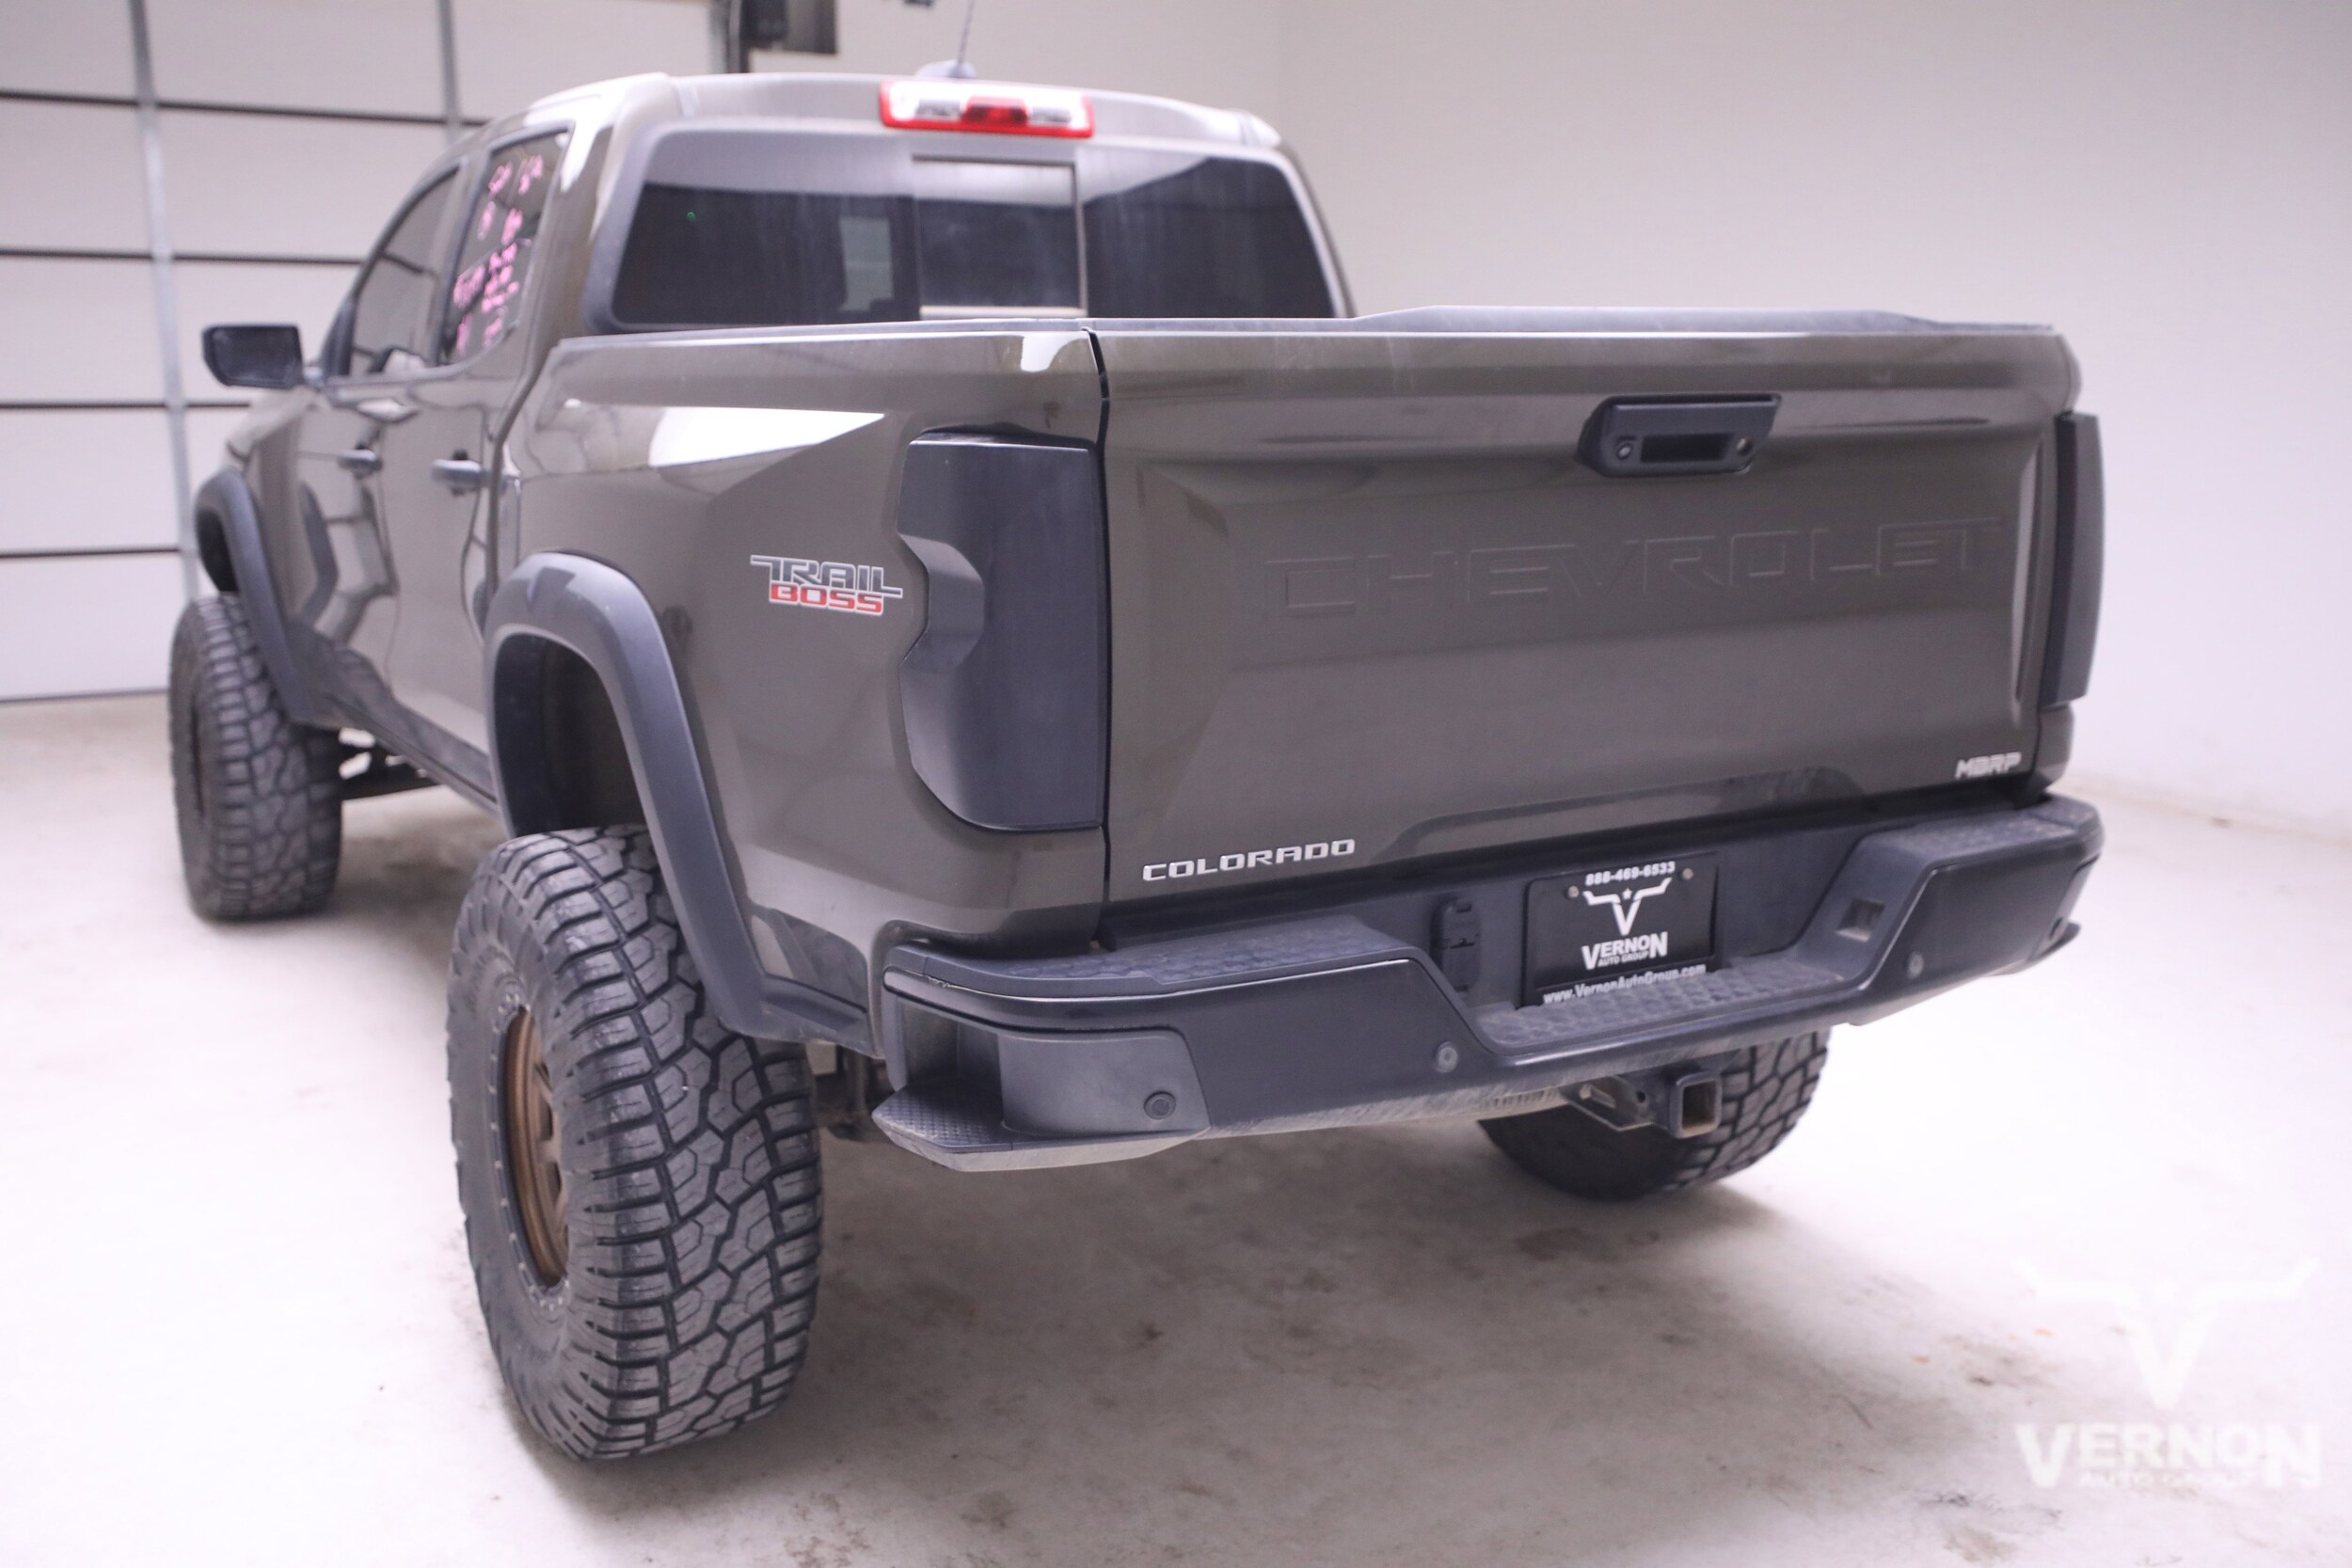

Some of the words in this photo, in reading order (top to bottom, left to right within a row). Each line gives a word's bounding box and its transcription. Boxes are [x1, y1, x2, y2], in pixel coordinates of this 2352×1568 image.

[750, 554, 903, 599] TRAIL
[1263, 516, 2002, 617] CHEVROLET
[769, 581, 883, 616] BOSS
[1142, 838, 1356, 881] COLORADO
[1585, 861, 1676, 886] 888-469-6533
[1581, 931, 1668, 970] VERNON
[1597, 956, 1620, 967] AUTO
[1621, 950, 1649, 963] GROUP
[1543, 964, 1707, 1004] www.VernonAutoGroup.com
